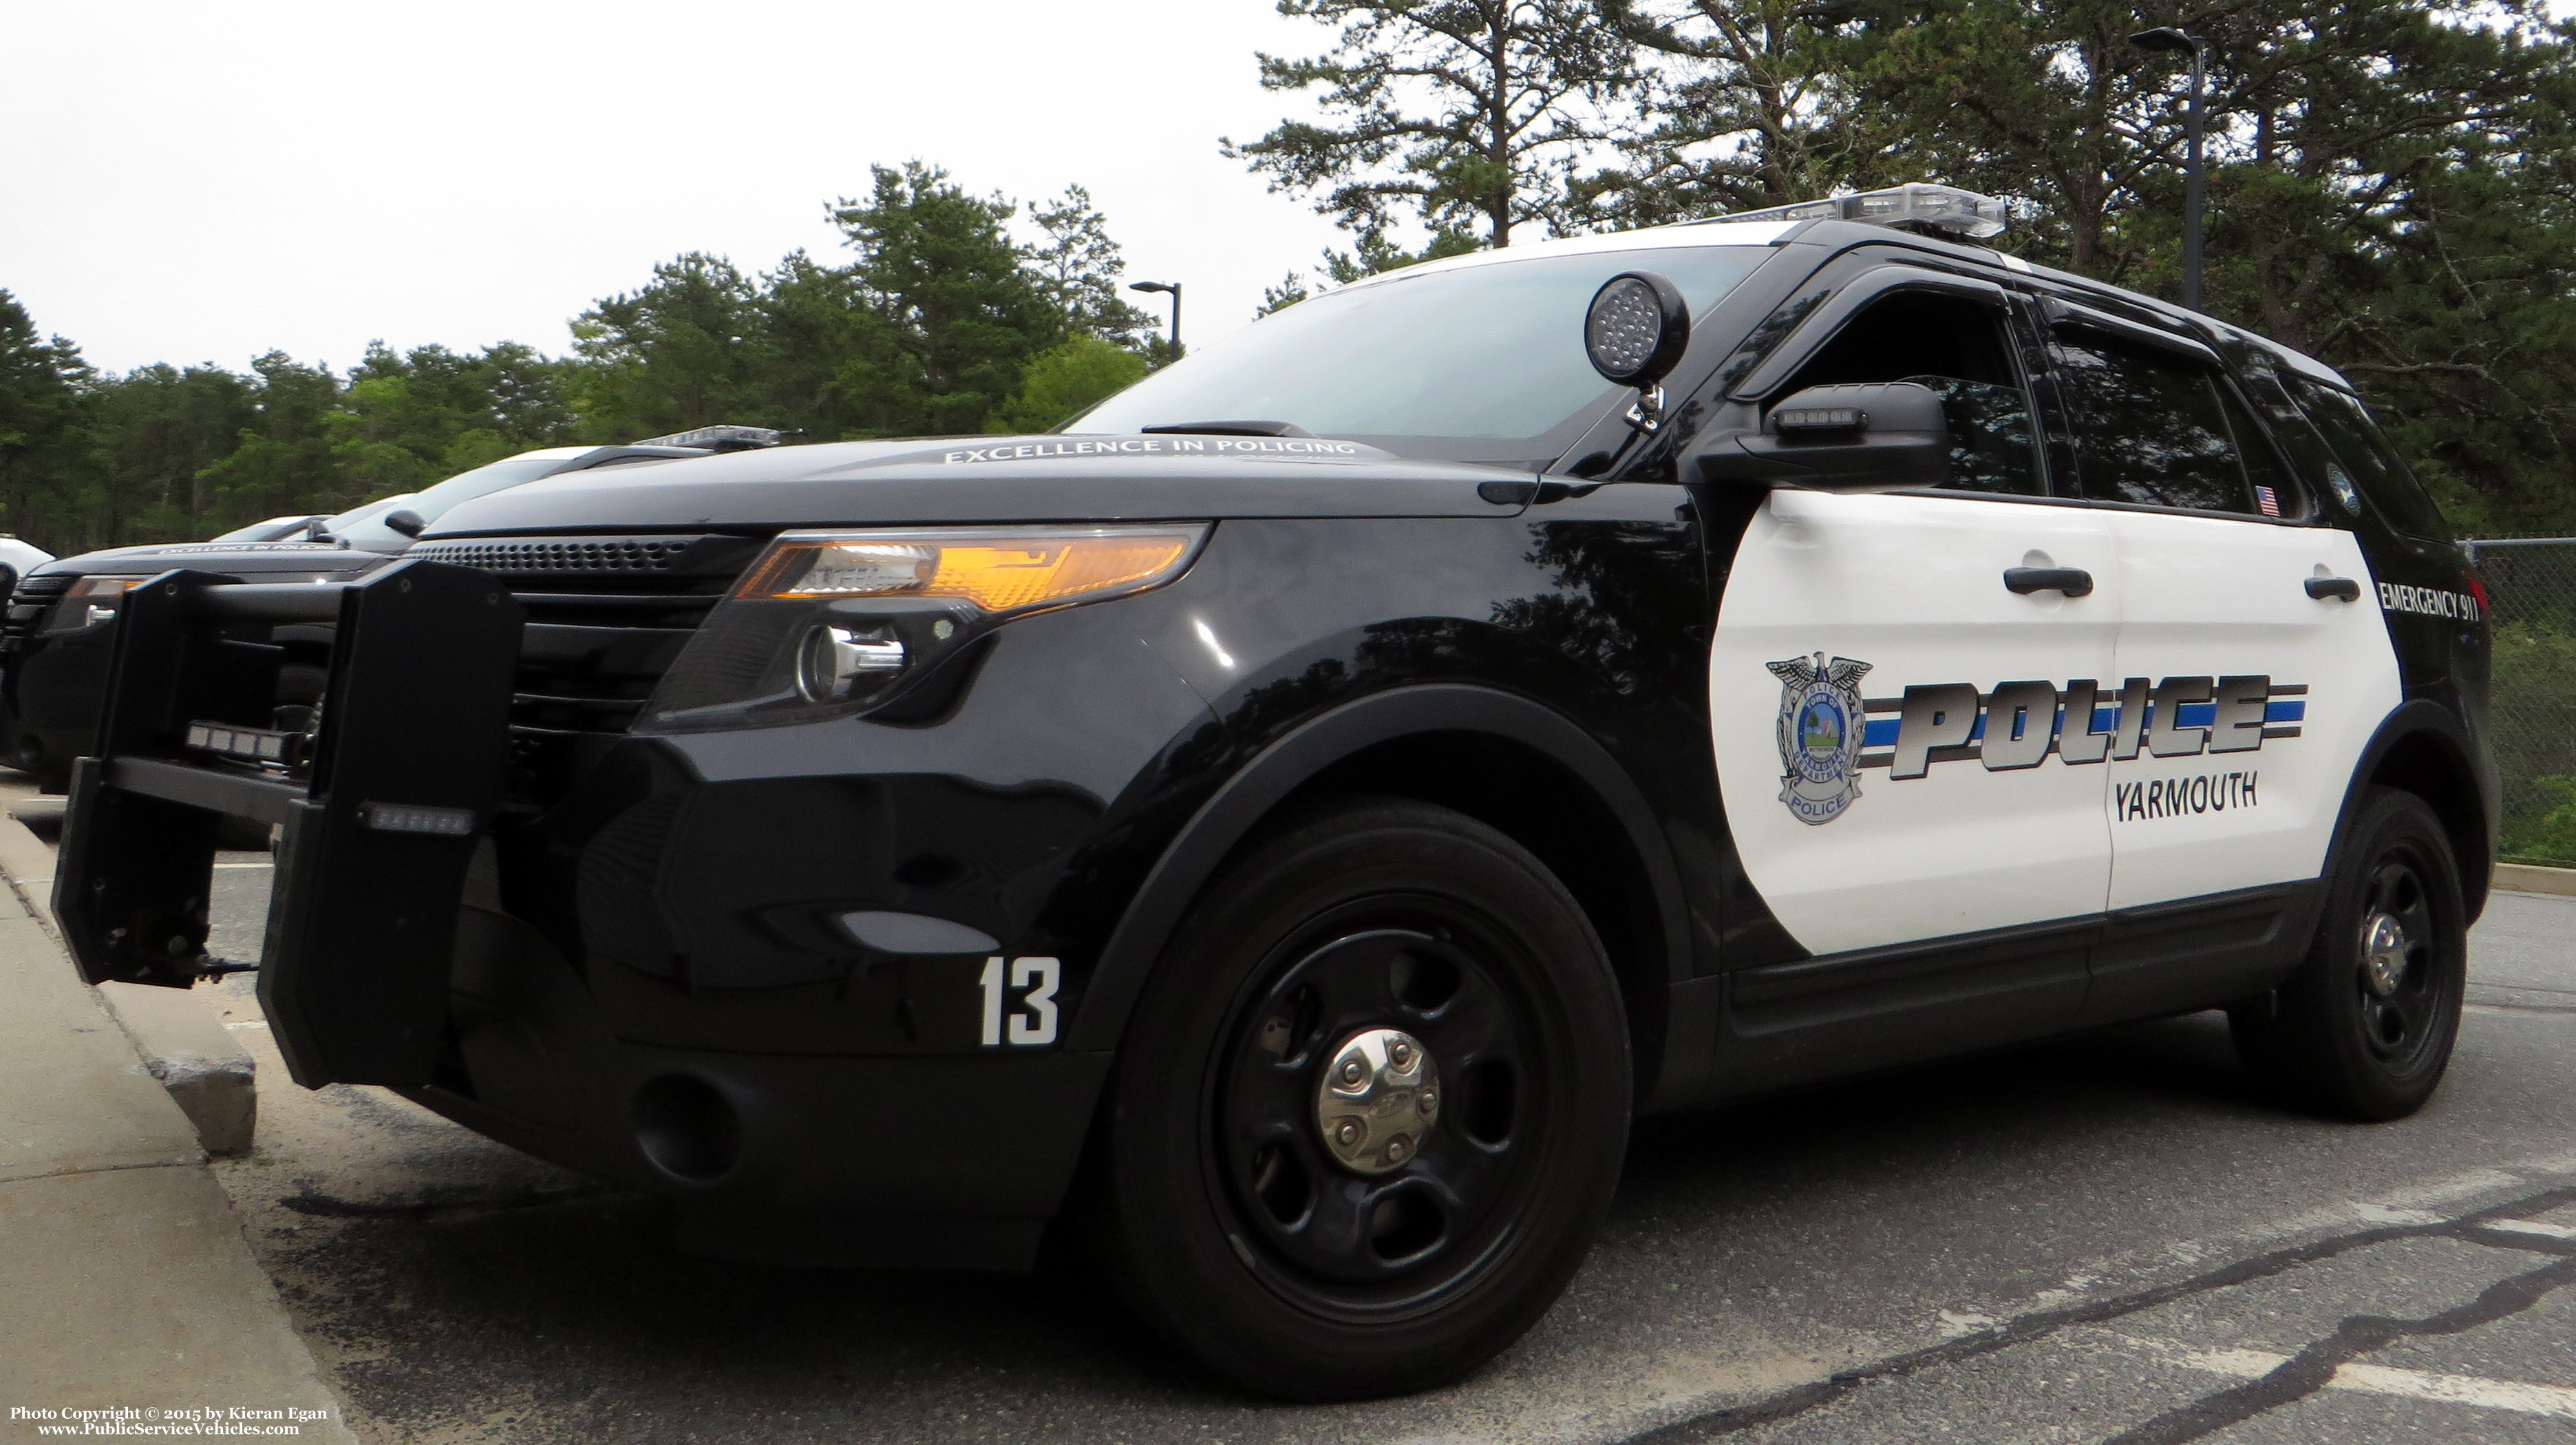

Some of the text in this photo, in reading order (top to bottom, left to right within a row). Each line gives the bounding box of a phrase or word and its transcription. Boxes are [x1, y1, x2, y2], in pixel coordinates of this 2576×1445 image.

[945, 439, 1356, 464] EXCELLENCE IN POLICING
[2378, 582, 2479, 622] EMERGENCY 911
[1803, 684, 1842, 700] POLICE
[1806, 695, 1839, 709] TOWN OF
[1890, 675, 2270, 781] POLICE
[1794, 749, 1848, 781] DEPARTMENT
[1791, 793, 1847, 816] POLICE
[2116, 770, 2259, 822] YARMOUTH
[980, 956, 1061, 1045] 13
